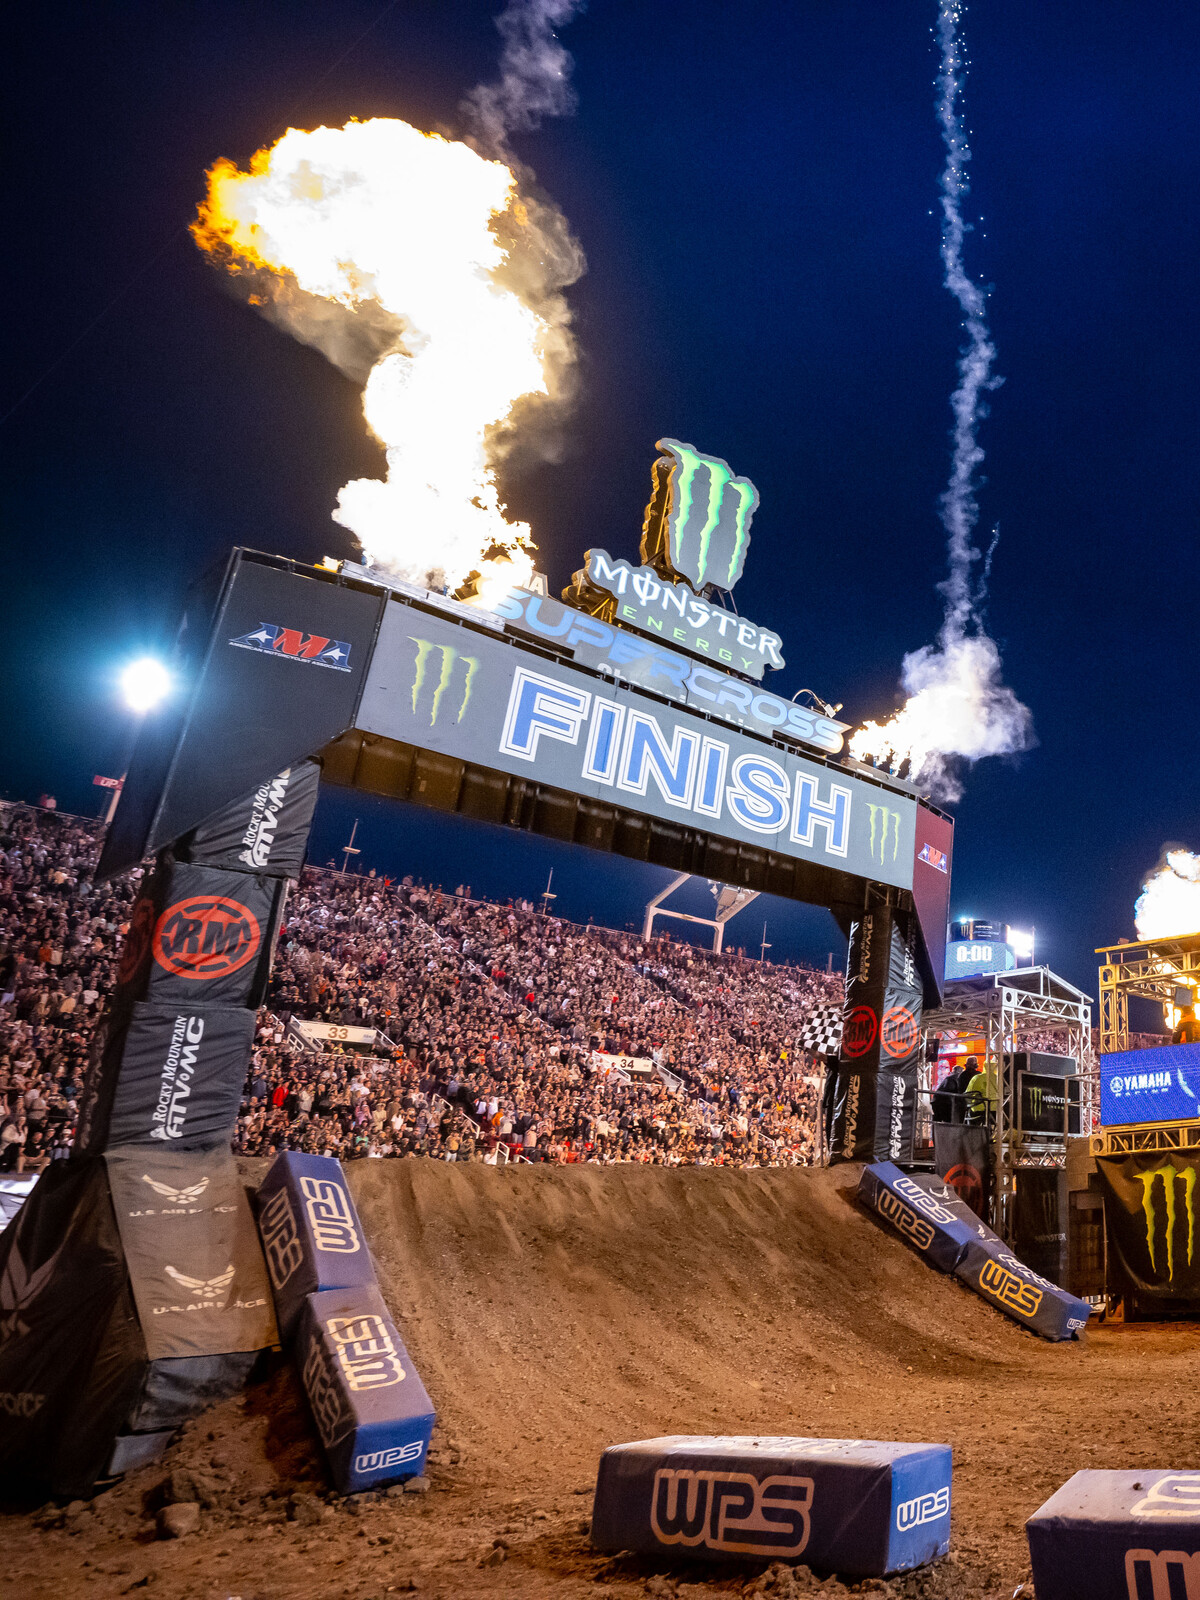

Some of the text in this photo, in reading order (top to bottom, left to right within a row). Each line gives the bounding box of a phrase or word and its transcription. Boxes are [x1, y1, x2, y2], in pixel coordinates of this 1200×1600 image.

[594, 555, 781, 663] MONSTER
[229, 621, 353, 669] AMA
[622, 605, 753, 669] ENERGY
[492, 587, 845, 747] SUPERCROSS
[499, 666, 852, 858] FINISH
[242, 811, 263, 848] ROCKY
[957, 945, 992, 962] 0:00
[328, 1027, 349, 1040] 33
[152, 1015, 188, 1124] ROCKY MOUNTAIN
[620, 1059, 635, 1069] 34
[1123, 1071, 1172, 1090] YAMAHA
[300, 1176, 360, 1253] WPS
[877, 1188, 936, 1250] WPS
[893, 1178, 958, 1224] WPS
[186, 1302, 214, 1311] AIR
[979, 1259, 1043, 1317] WPS
[1066, 1318, 1086, 1330] WPS
[356, 1441, 424, 1474] WPS
[651, 1468, 814, 1558] WPS
[897, 1486, 950, 1532] WPS
